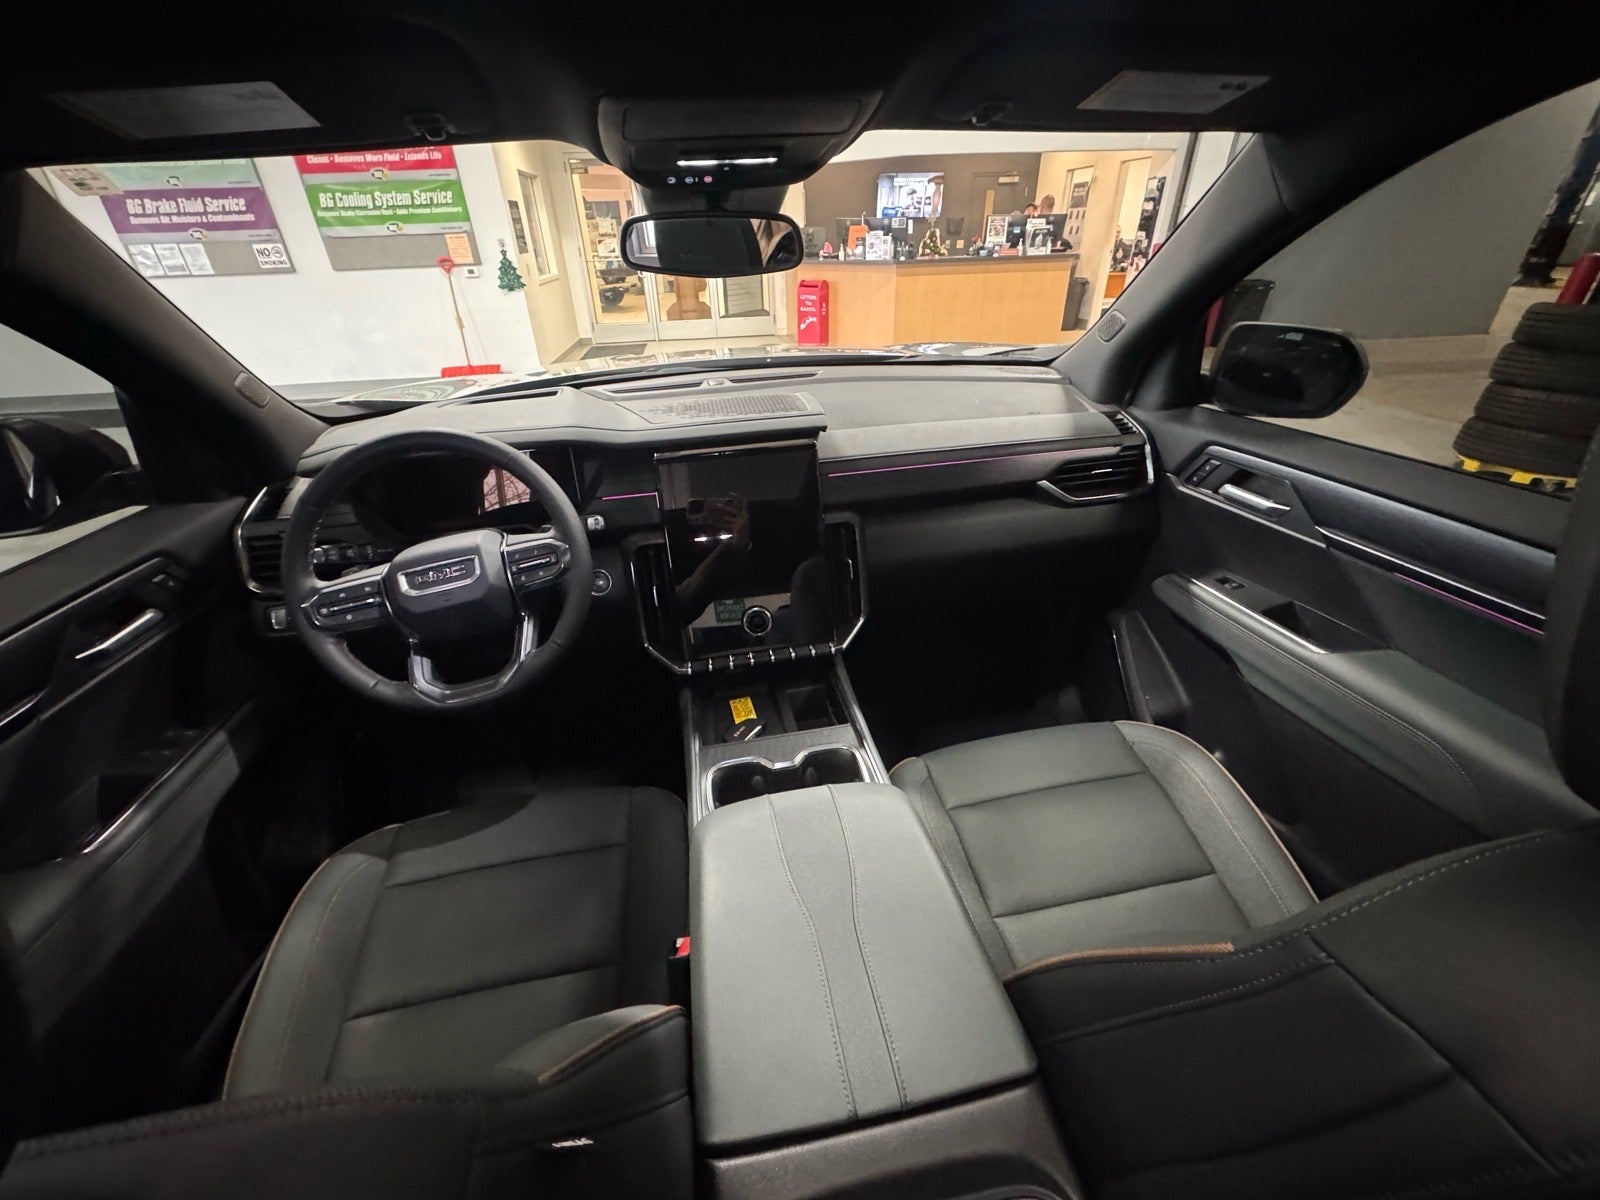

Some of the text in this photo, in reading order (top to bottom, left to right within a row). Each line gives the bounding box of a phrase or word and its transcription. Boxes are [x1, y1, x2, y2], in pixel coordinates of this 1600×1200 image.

[333, 154, 365, 163] Removes
[365, 153, 383, 163] Worn
[383, 152, 400, 162] Fluid
[429, 150, 442, 160] Life
[126, 195, 246, 215] BG Brake Fluid Service
[318, 189, 453, 209] BG Cooling System Service
[129, 215, 160, 225] Removes
[171, 215, 202, 224] Moisture
[208, 213, 256, 223] Contaminants
[255, 247, 271, 257] NO
[414, 564, 466, 584] GMC
